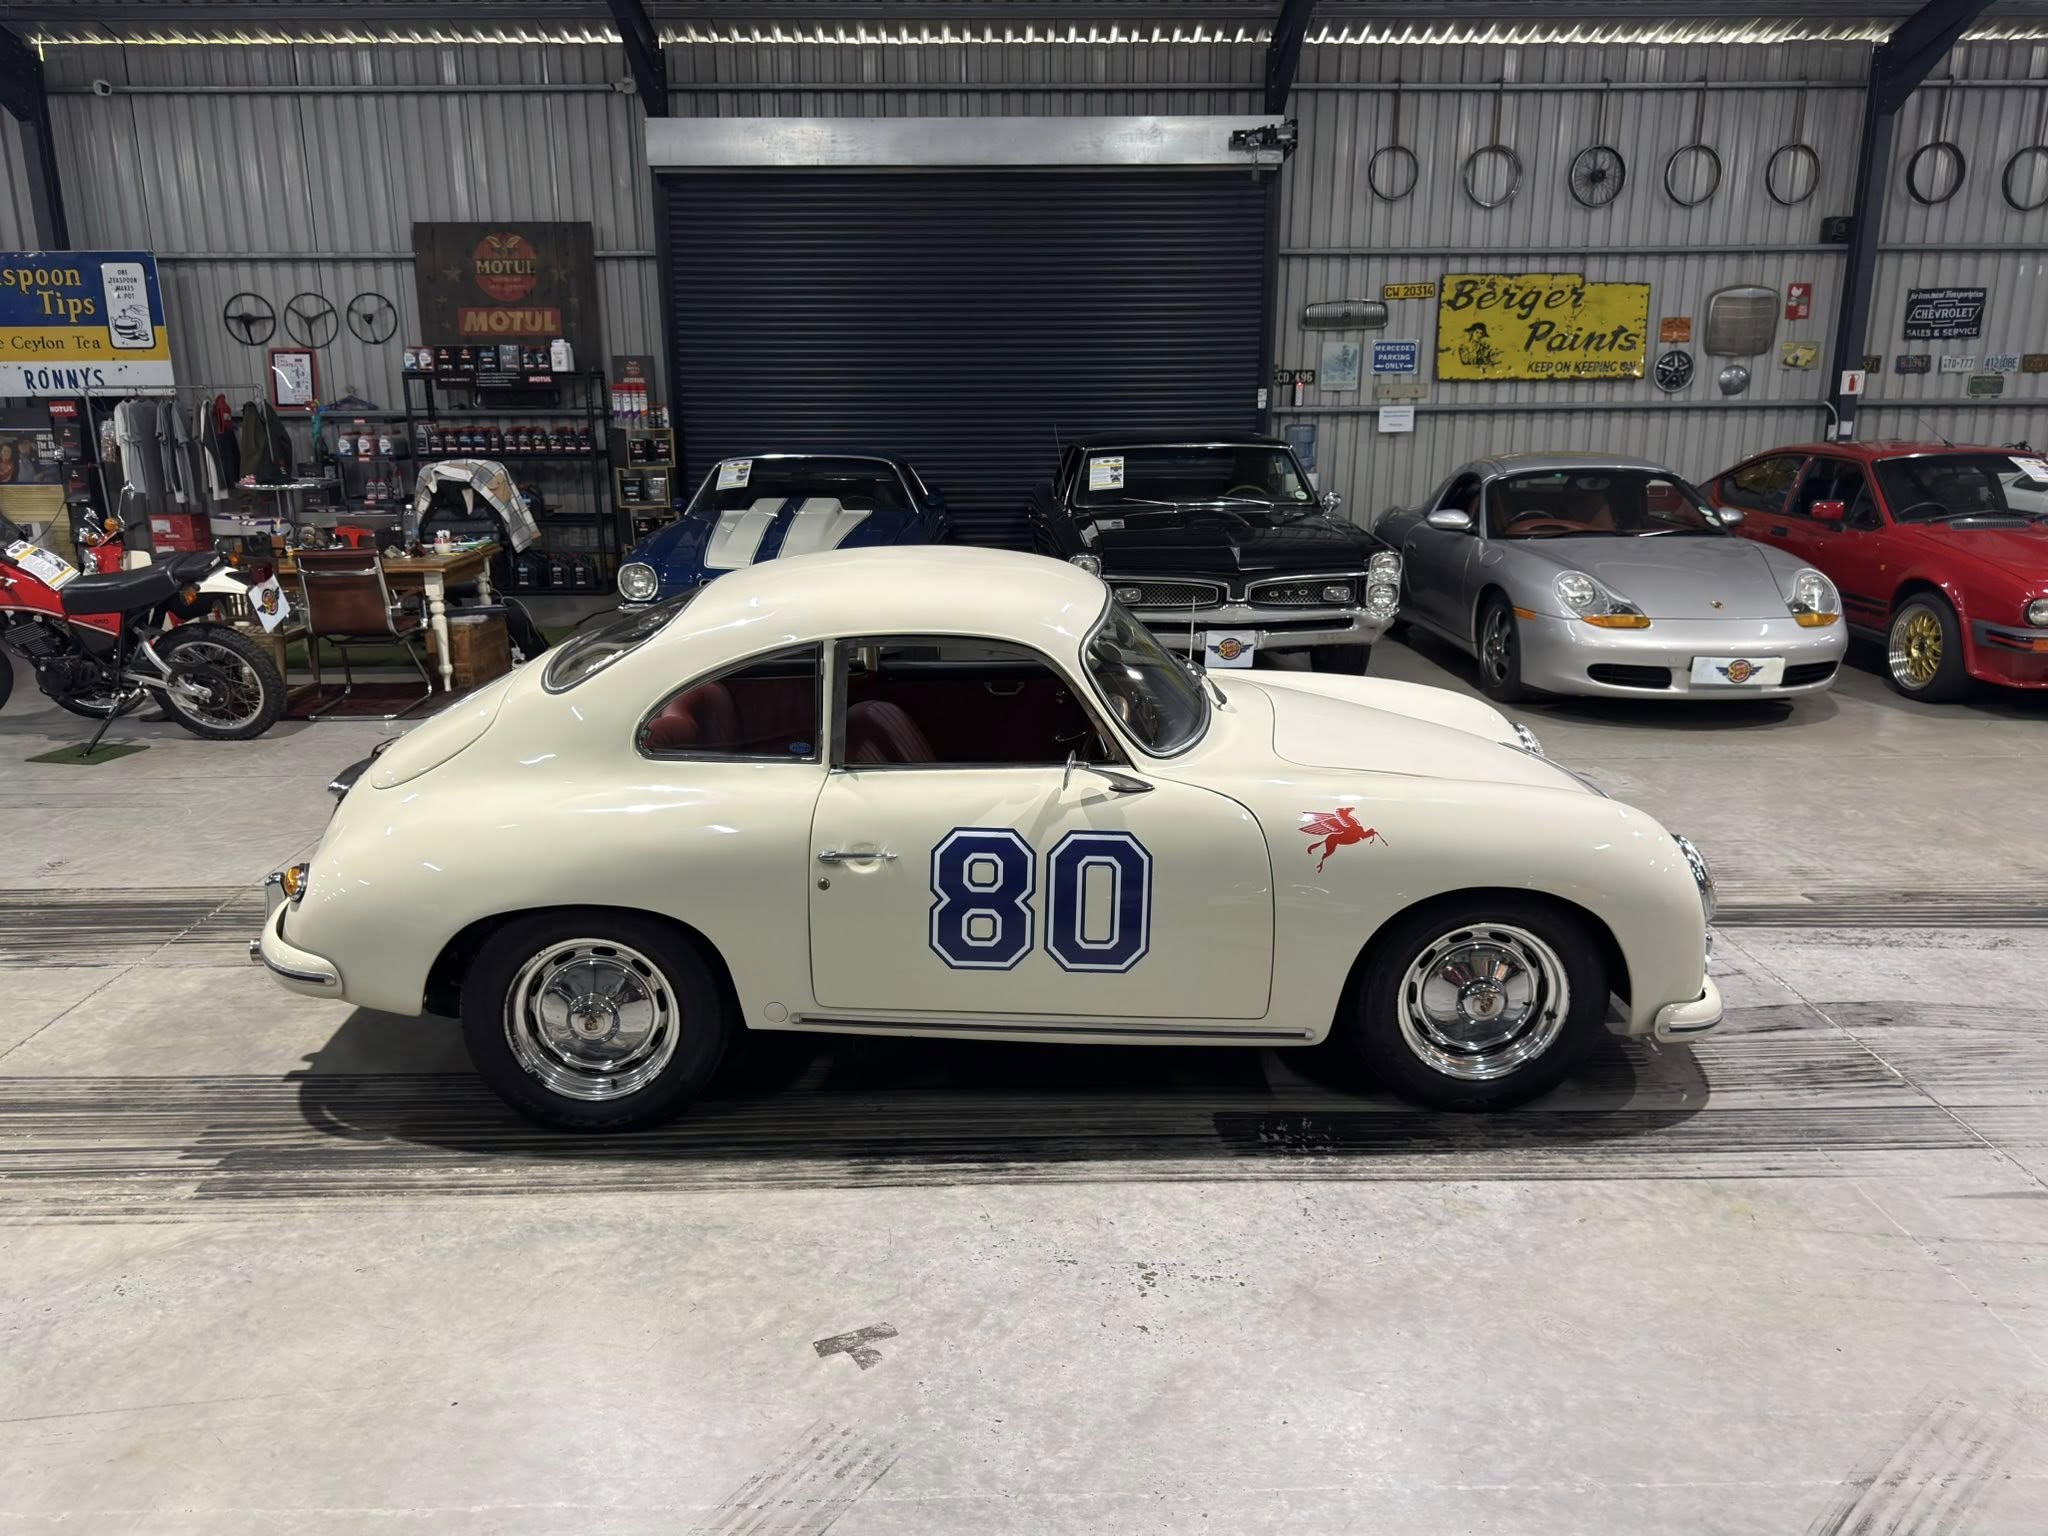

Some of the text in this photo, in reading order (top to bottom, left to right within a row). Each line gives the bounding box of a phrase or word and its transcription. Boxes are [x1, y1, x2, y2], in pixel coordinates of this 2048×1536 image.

[476, 259, 536, 274] MOTUL
[0, 268, 82, 294] spoon
[1385, 285, 1433, 297] CW 20314
[1447, 279, 1585, 320] Berger
[36, 289, 96, 323] Tips
[1915, 307, 1975, 319] CHEVROLET
[464, 311, 556, 332] MOTUL
[1523, 320, 1640, 352] Paints
[1906, 329, 1931, 337] SALES
[1942, 327, 1978, 336] SERVICE
[11, 335, 65, 352] Ceylon
[72, 335, 101, 349] Tea
[1527, 360, 1553, 373] KEEP
[1555, 361, 1571, 373] ON
[24, 369, 105, 390] RONNYS
[49, 405, 74, 413] MOTUL
[928, 826, 1153, 974] 80
